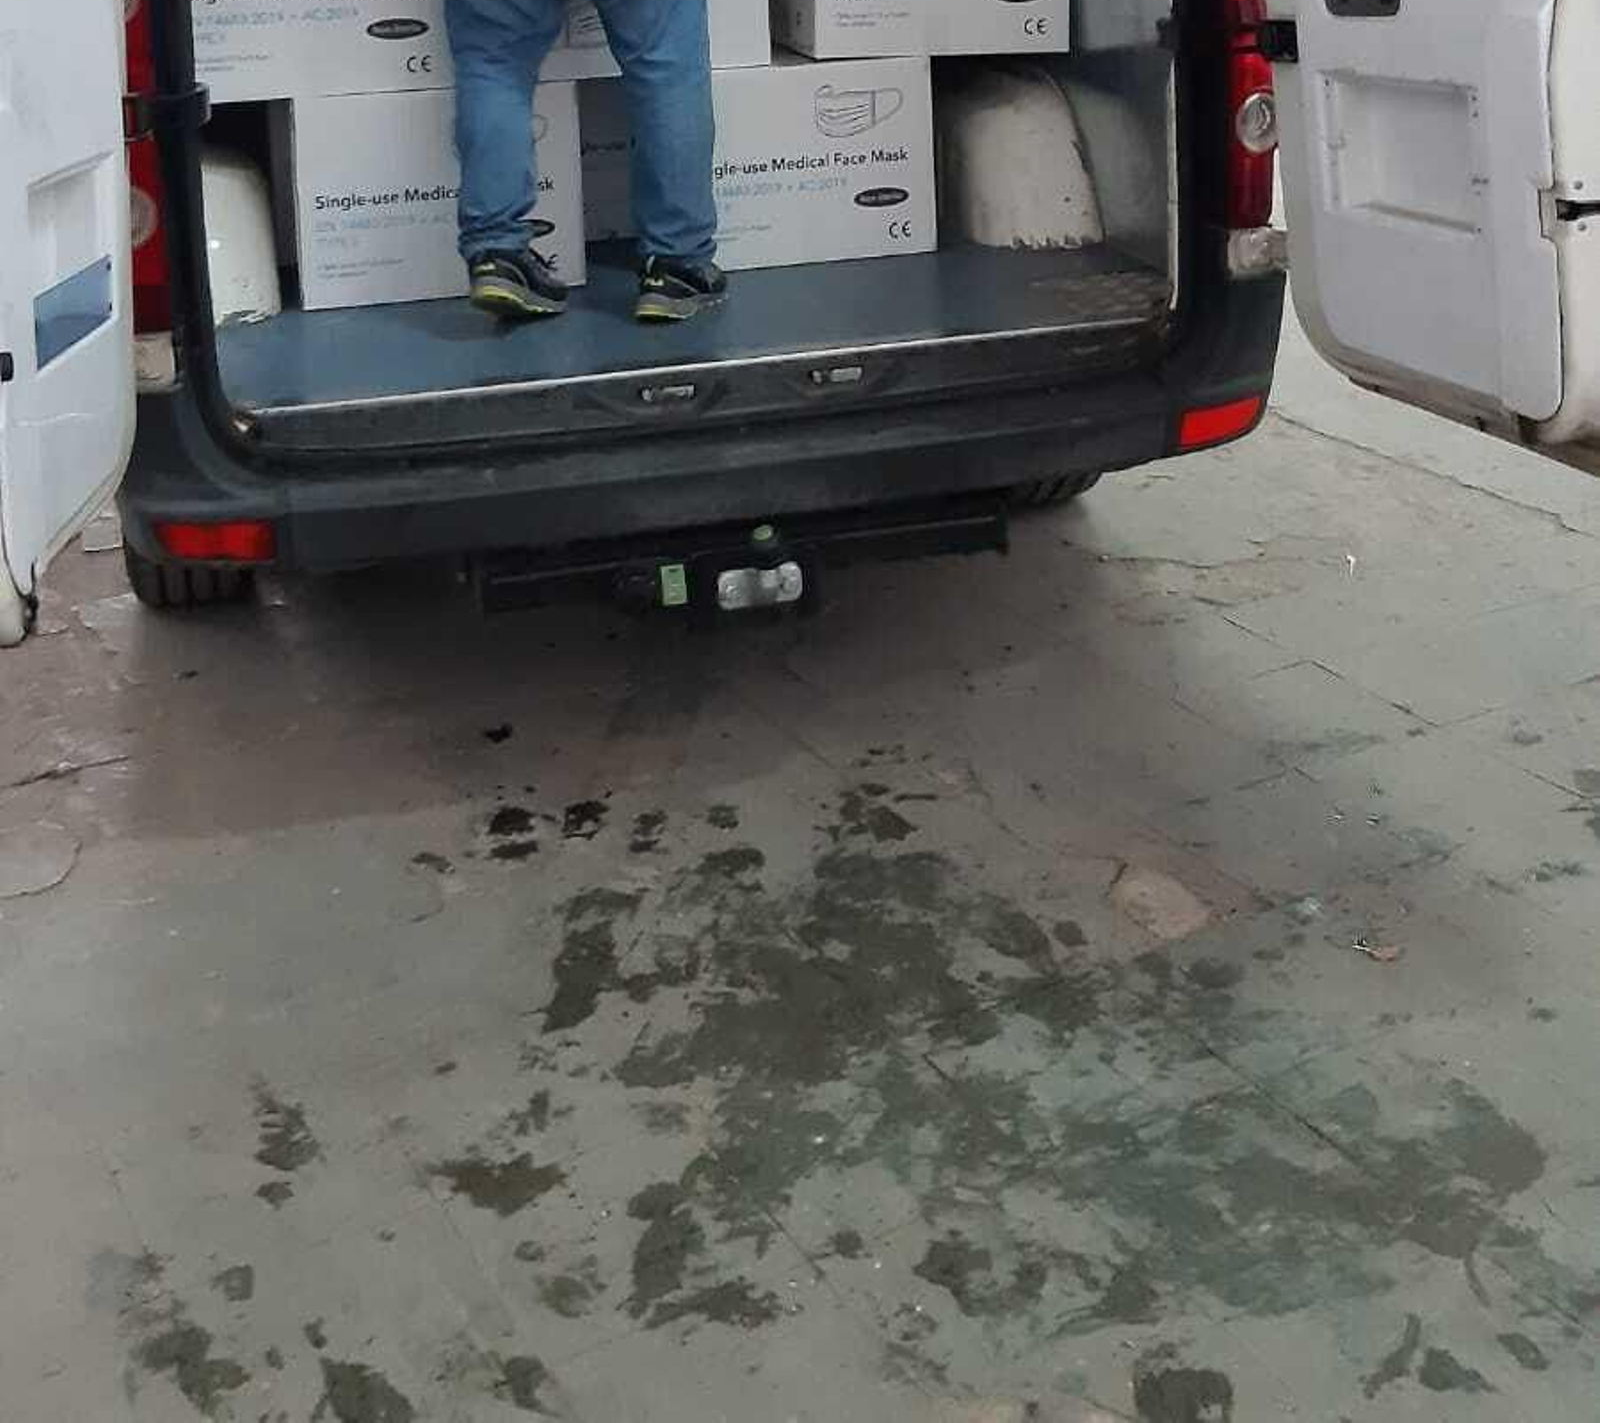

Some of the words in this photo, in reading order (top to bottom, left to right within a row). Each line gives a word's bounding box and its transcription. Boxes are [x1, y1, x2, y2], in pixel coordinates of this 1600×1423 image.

[714, 163, 768, 178] gle-use
[772, 153, 830, 172] Medical
[833, 152, 867, 167] Face
[870, 147, 909, 163] Mask
[315, 191, 399, 212] Single-use
[404, 186, 460, 203] Medic
